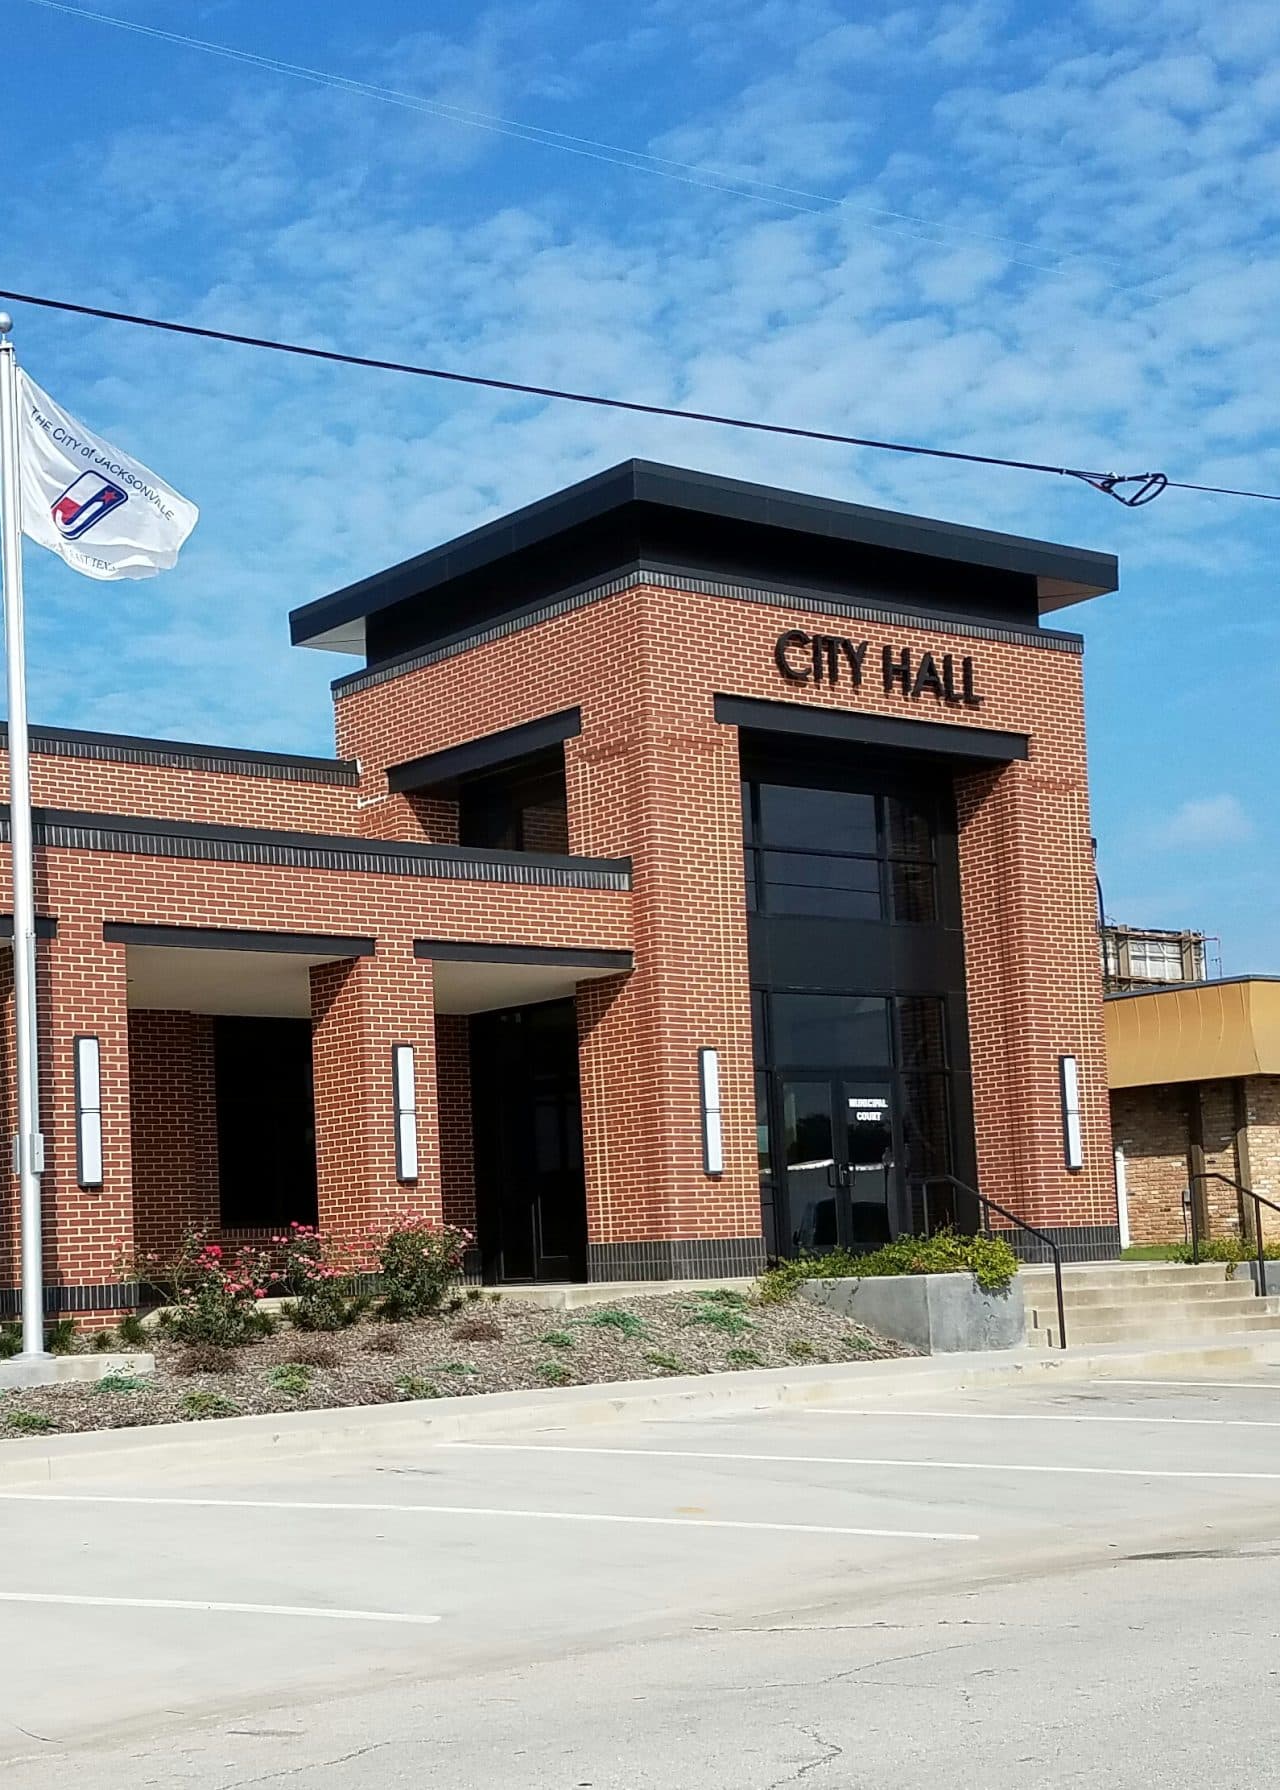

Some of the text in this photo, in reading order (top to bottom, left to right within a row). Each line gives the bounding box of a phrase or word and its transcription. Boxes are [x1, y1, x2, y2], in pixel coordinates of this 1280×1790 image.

[31, 405, 53, 431] THE
[52, 428, 81, 450] CITY
[80, 446, 96, 459] of
[775, 629, 984, 707] CITY HALL
[856, 1111, 882, 1121] COURT
